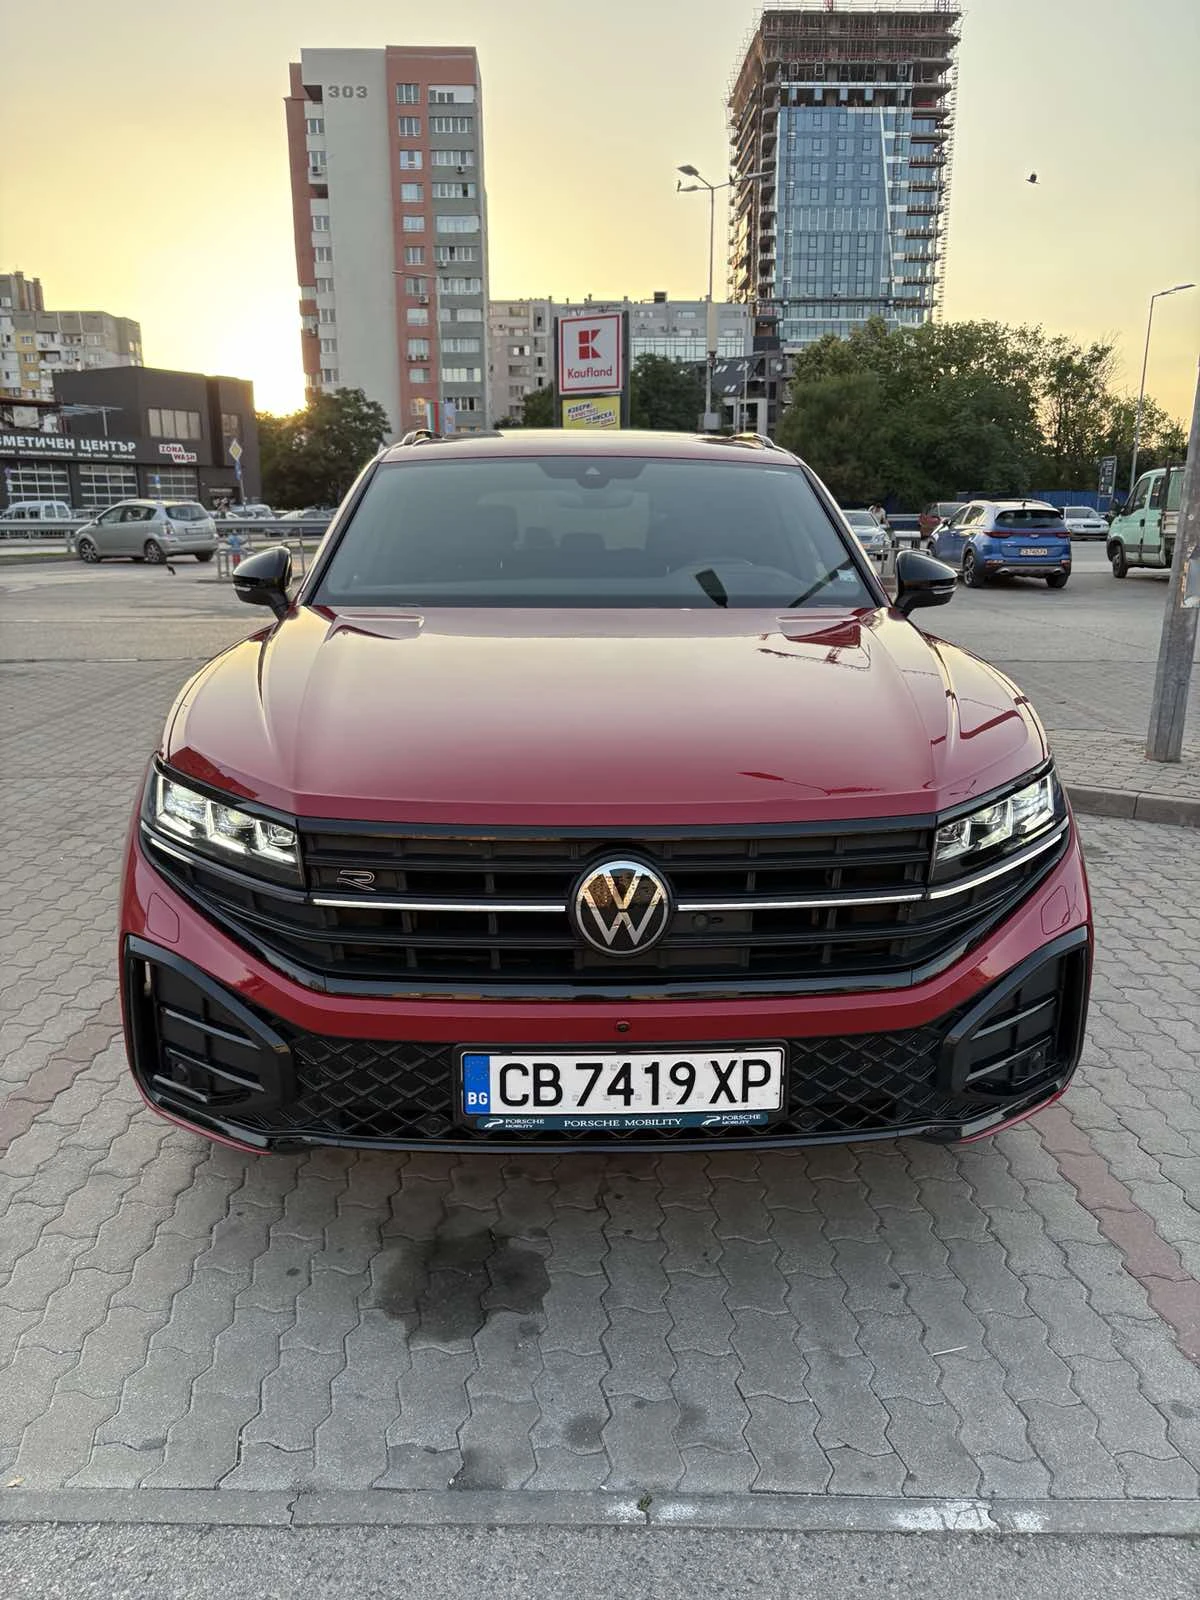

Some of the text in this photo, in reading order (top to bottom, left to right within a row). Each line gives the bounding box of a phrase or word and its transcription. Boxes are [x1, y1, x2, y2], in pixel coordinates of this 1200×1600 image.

[328, 86, 368, 98] 303
[567, 365, 613, 379] Kaufland
[80, 439, 136, 453] ЦЕНТЪР
[174, 453, 195, 461] WASH
[500, 1059, 771, 1107] CB 7419 XP
[467, 1092, 488, 1105] BG
[564, 1118, 682, 1127] PORSCHE MOBILITY
[722, 1113, 761, 1121] PORSCHE
